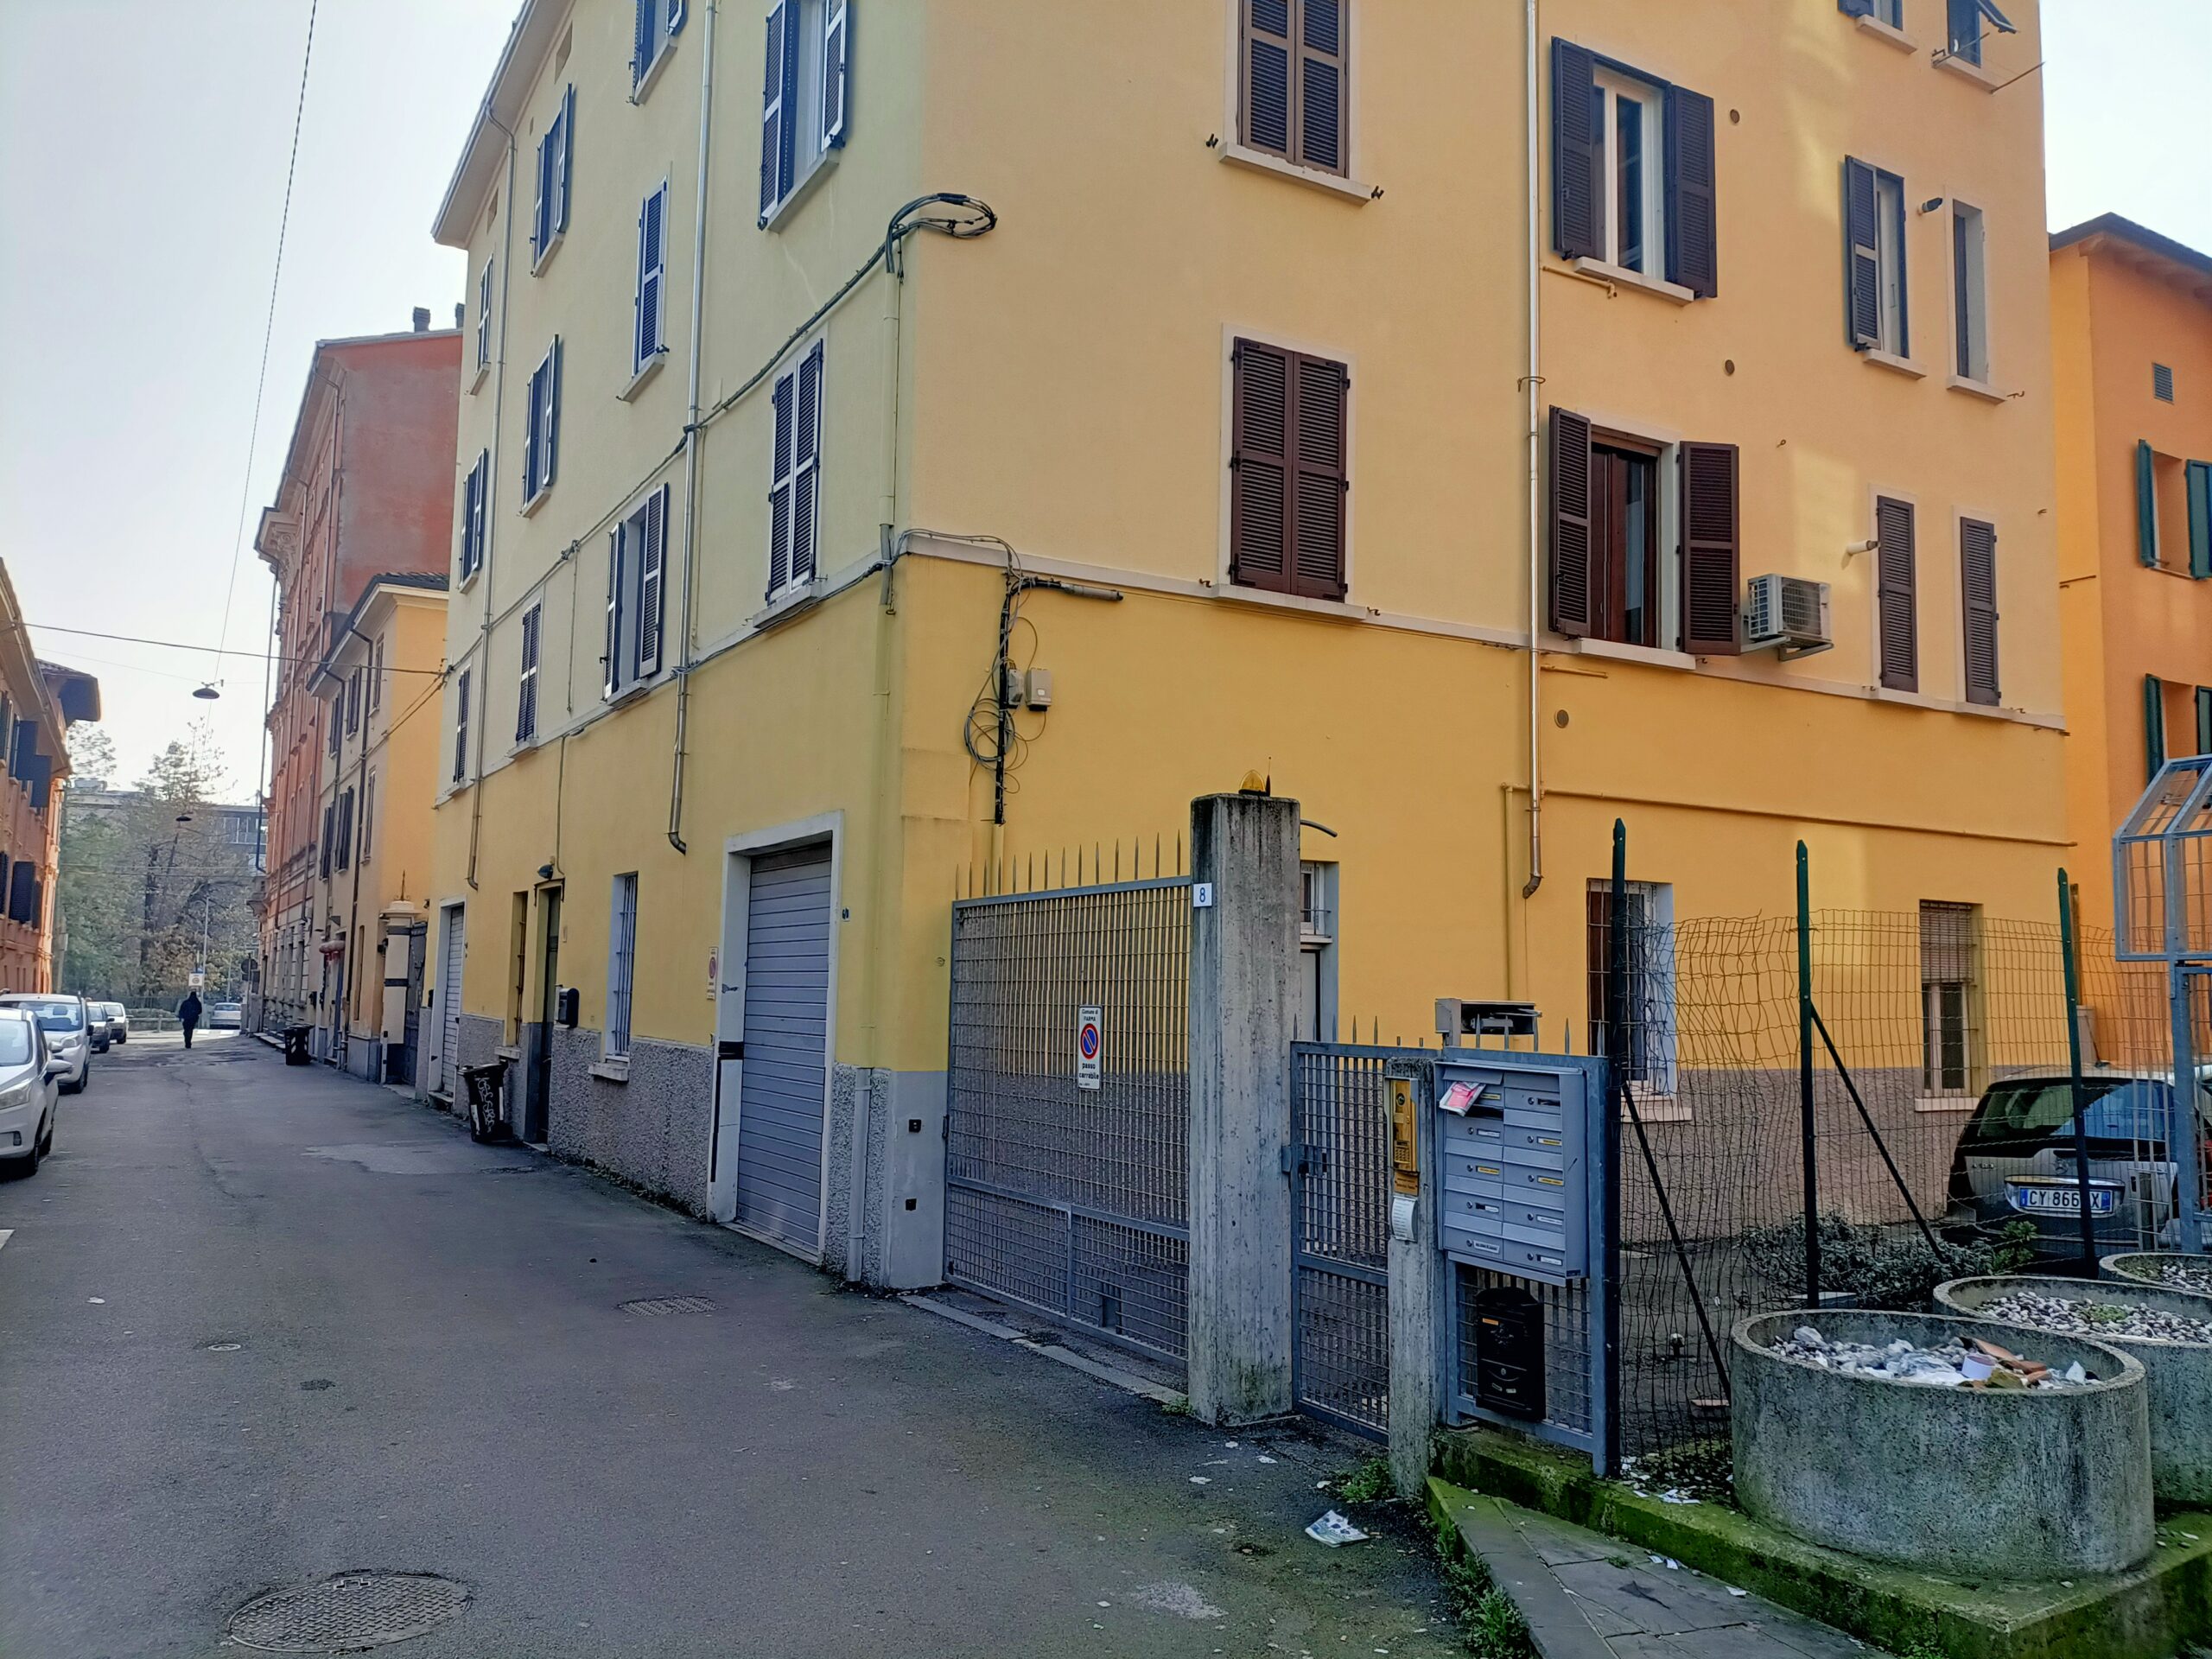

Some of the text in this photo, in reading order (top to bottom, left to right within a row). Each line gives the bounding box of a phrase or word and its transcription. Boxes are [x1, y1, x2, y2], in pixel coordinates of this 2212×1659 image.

[1199, 887, 1206, 903] 8
[1078, 1071, 1099, 1080] carrabile
[2030, 1190, 2100, 1209] CY 866X
